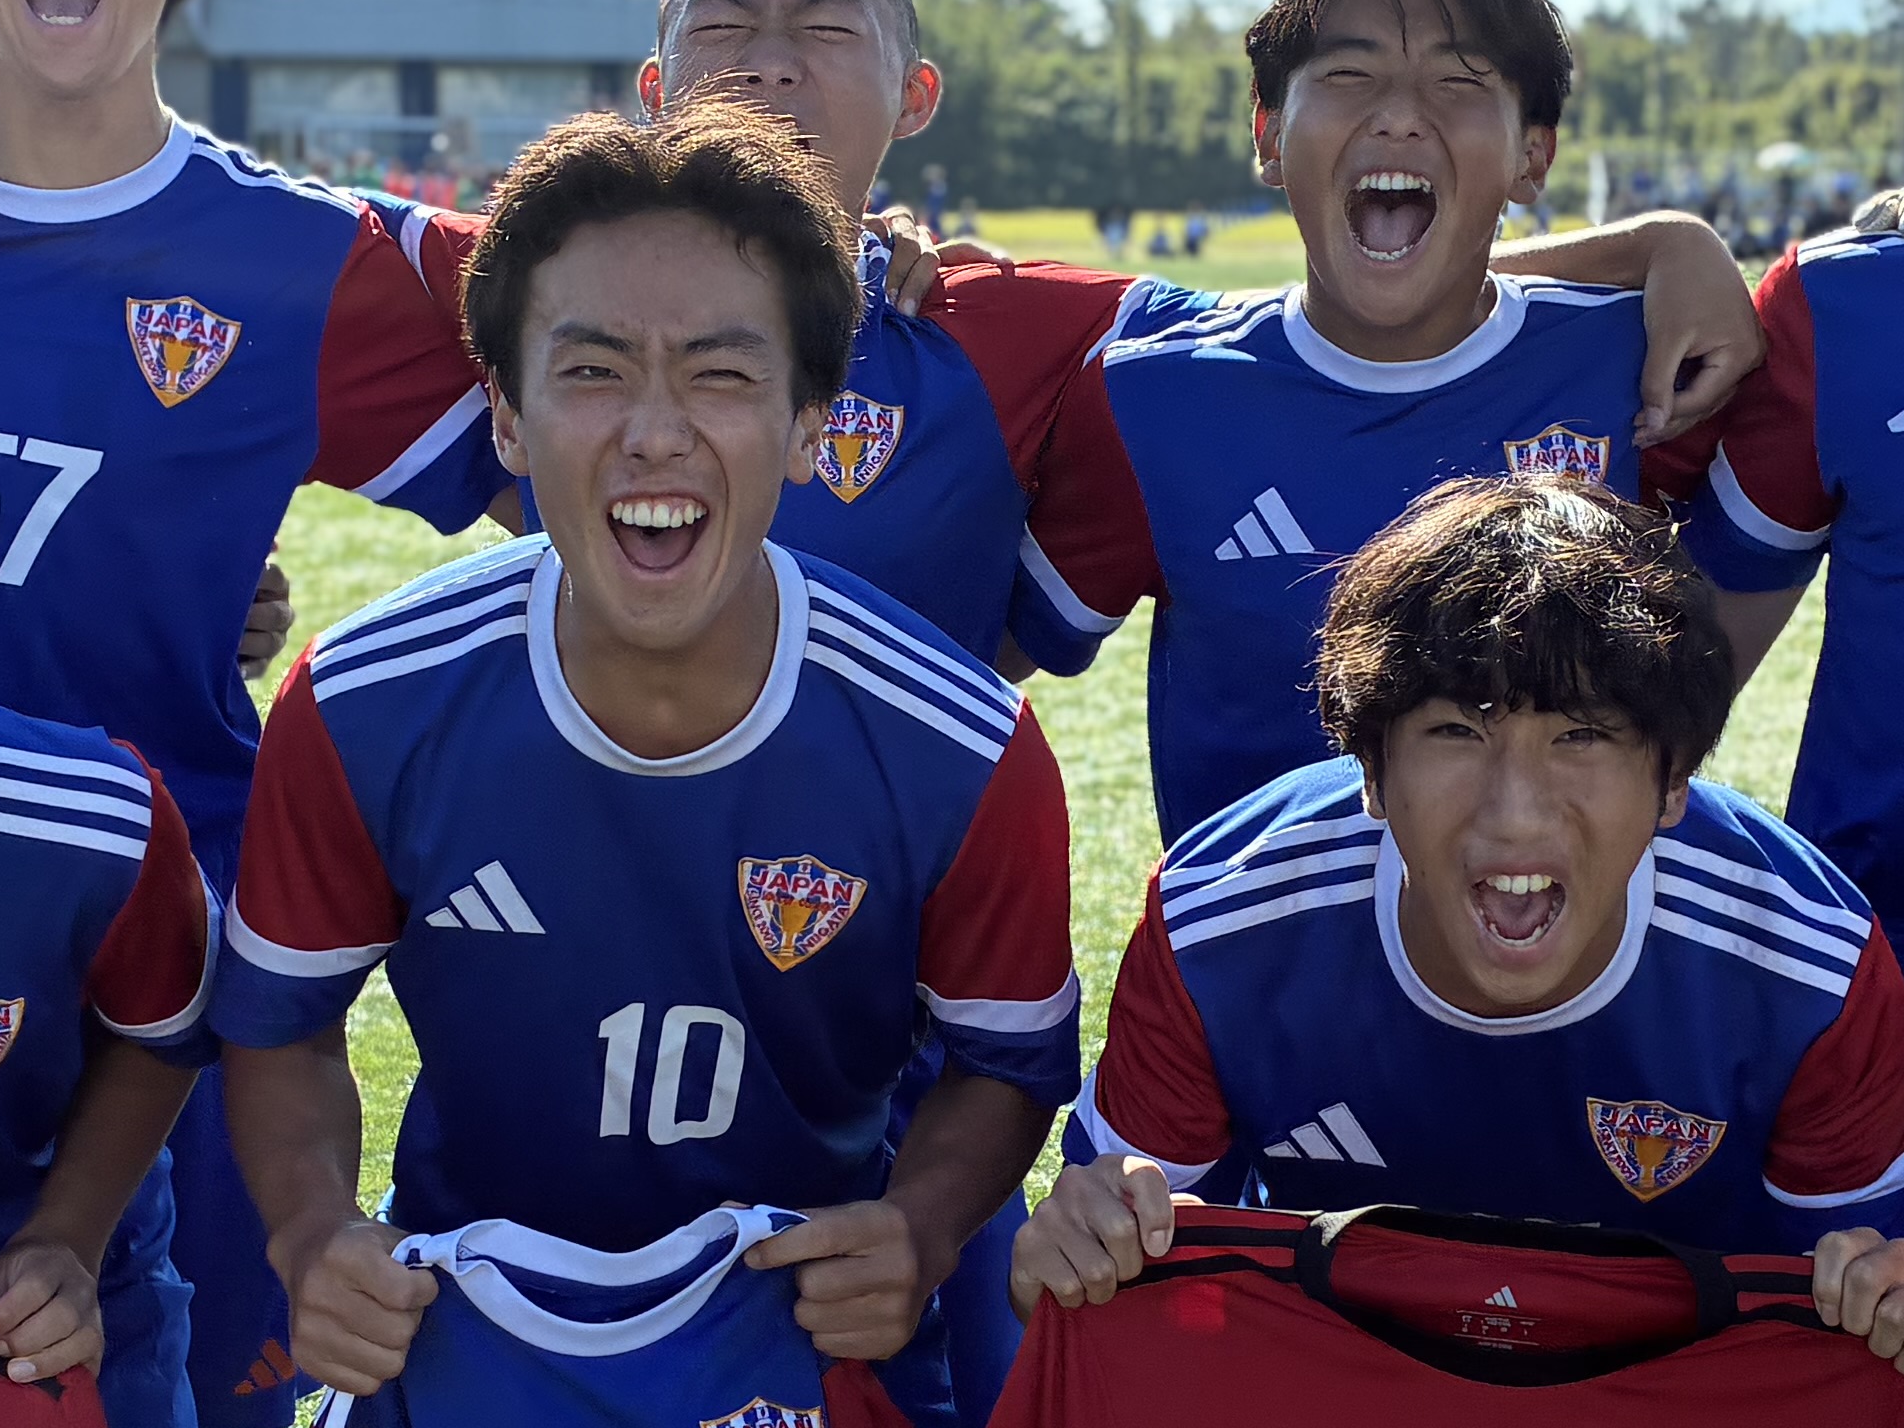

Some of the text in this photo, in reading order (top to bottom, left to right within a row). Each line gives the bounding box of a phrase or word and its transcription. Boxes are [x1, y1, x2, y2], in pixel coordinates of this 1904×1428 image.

[137, 307, 228, 344] JAPAN
[826, 412, 894, 430] APAN
[750, 870, 854, 902] JAPAN
[598, 1003, 745, 1145] 10
[1600, 1108, 1711, 1140] JAPAN
